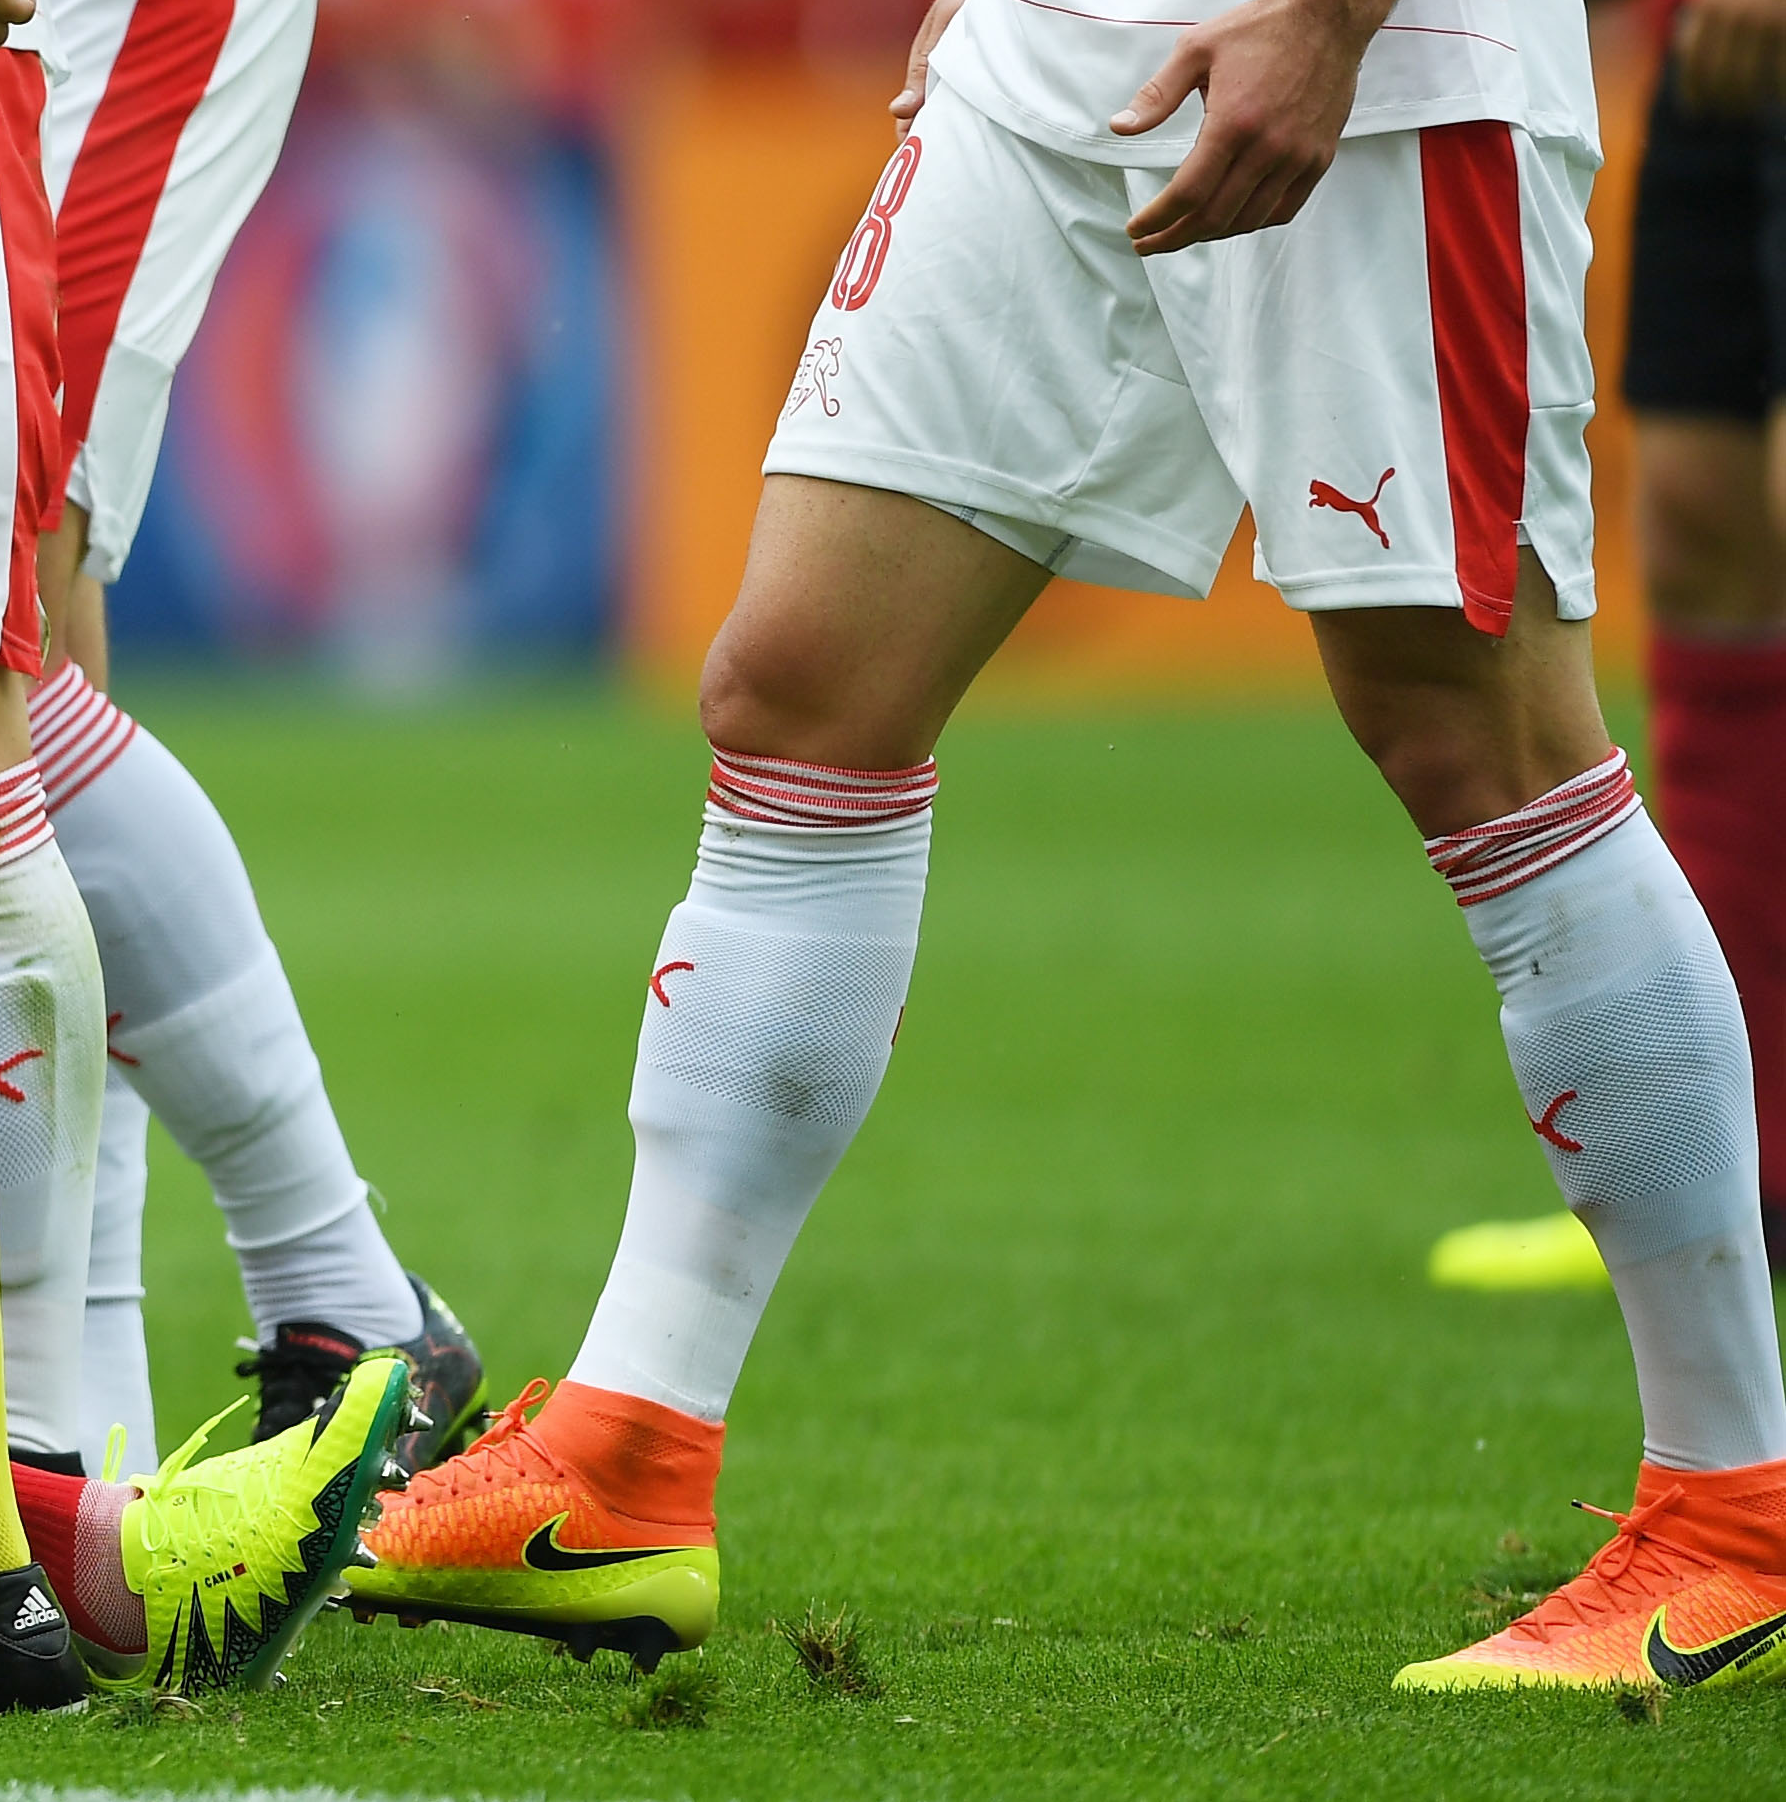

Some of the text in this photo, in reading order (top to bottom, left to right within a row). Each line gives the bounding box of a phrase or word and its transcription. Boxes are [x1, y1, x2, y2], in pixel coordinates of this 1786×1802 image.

[832, 135, 922, 312] 8
[13, 1608, 60, 1630] adidas
[1735, 1638, 1776, 1672] MEHMEDI
